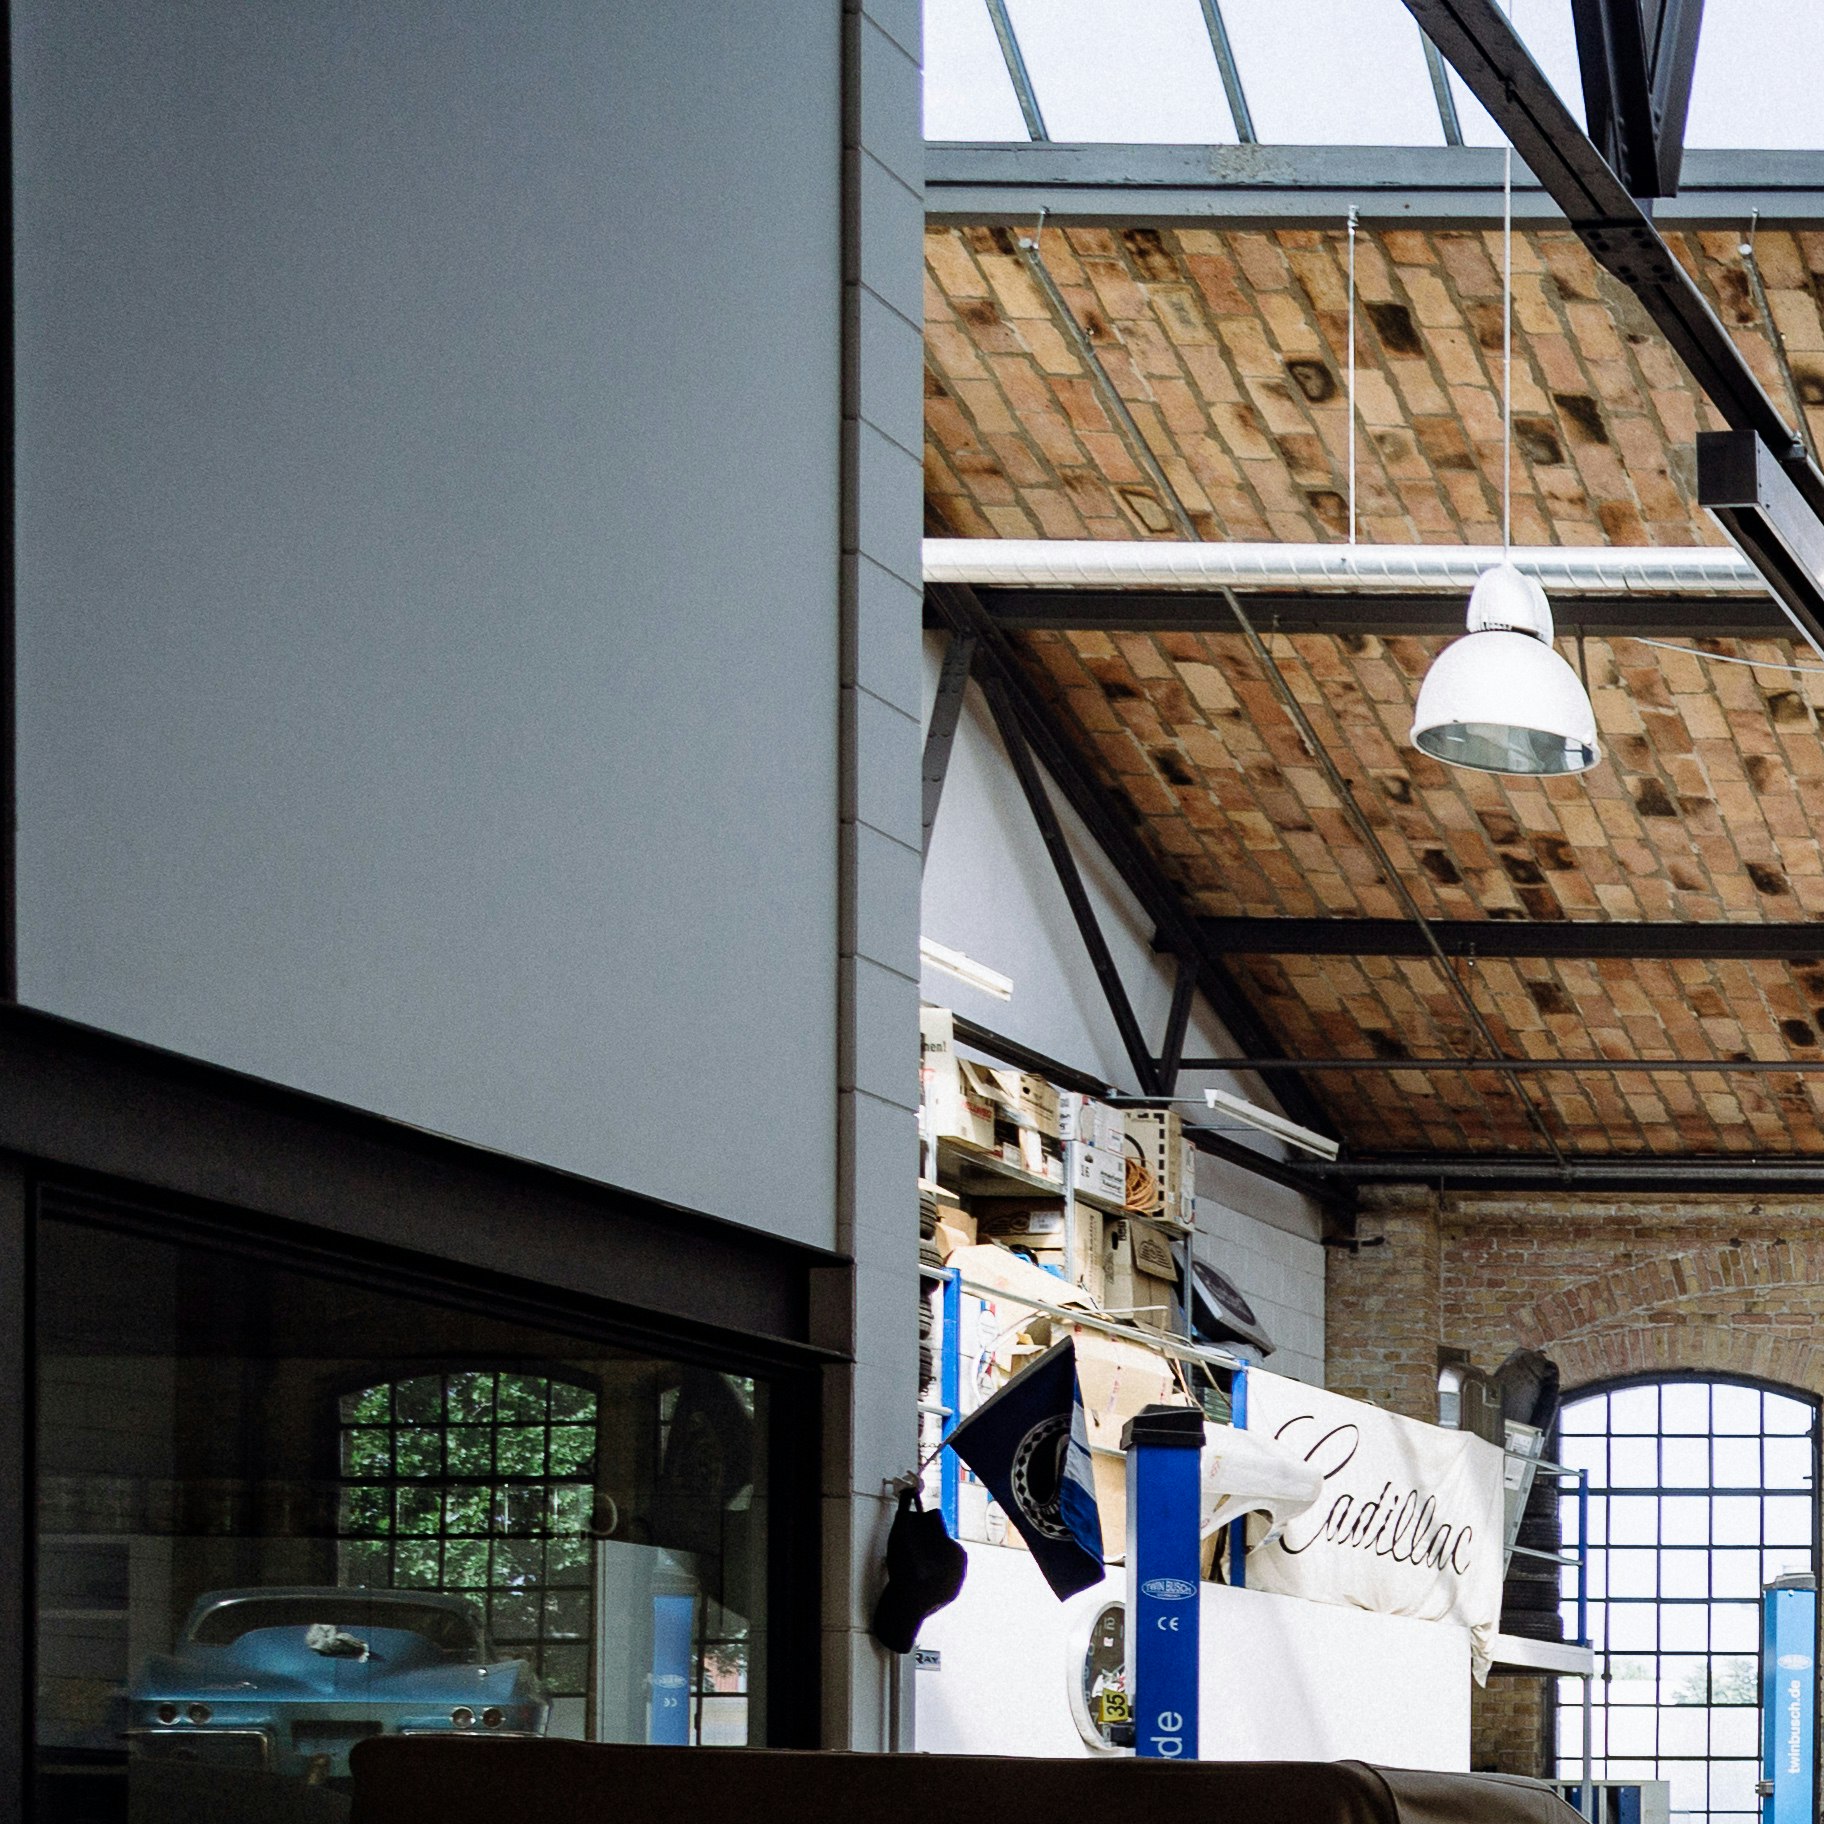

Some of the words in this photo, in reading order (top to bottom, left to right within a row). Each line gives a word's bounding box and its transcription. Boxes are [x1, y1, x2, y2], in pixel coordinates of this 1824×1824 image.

[1274, 1414, 1473, 1576] Cadillac
[1106, 1693, 1126, 1717] 35
[1787, 1679, 1802, 1775] twinbusch.de
